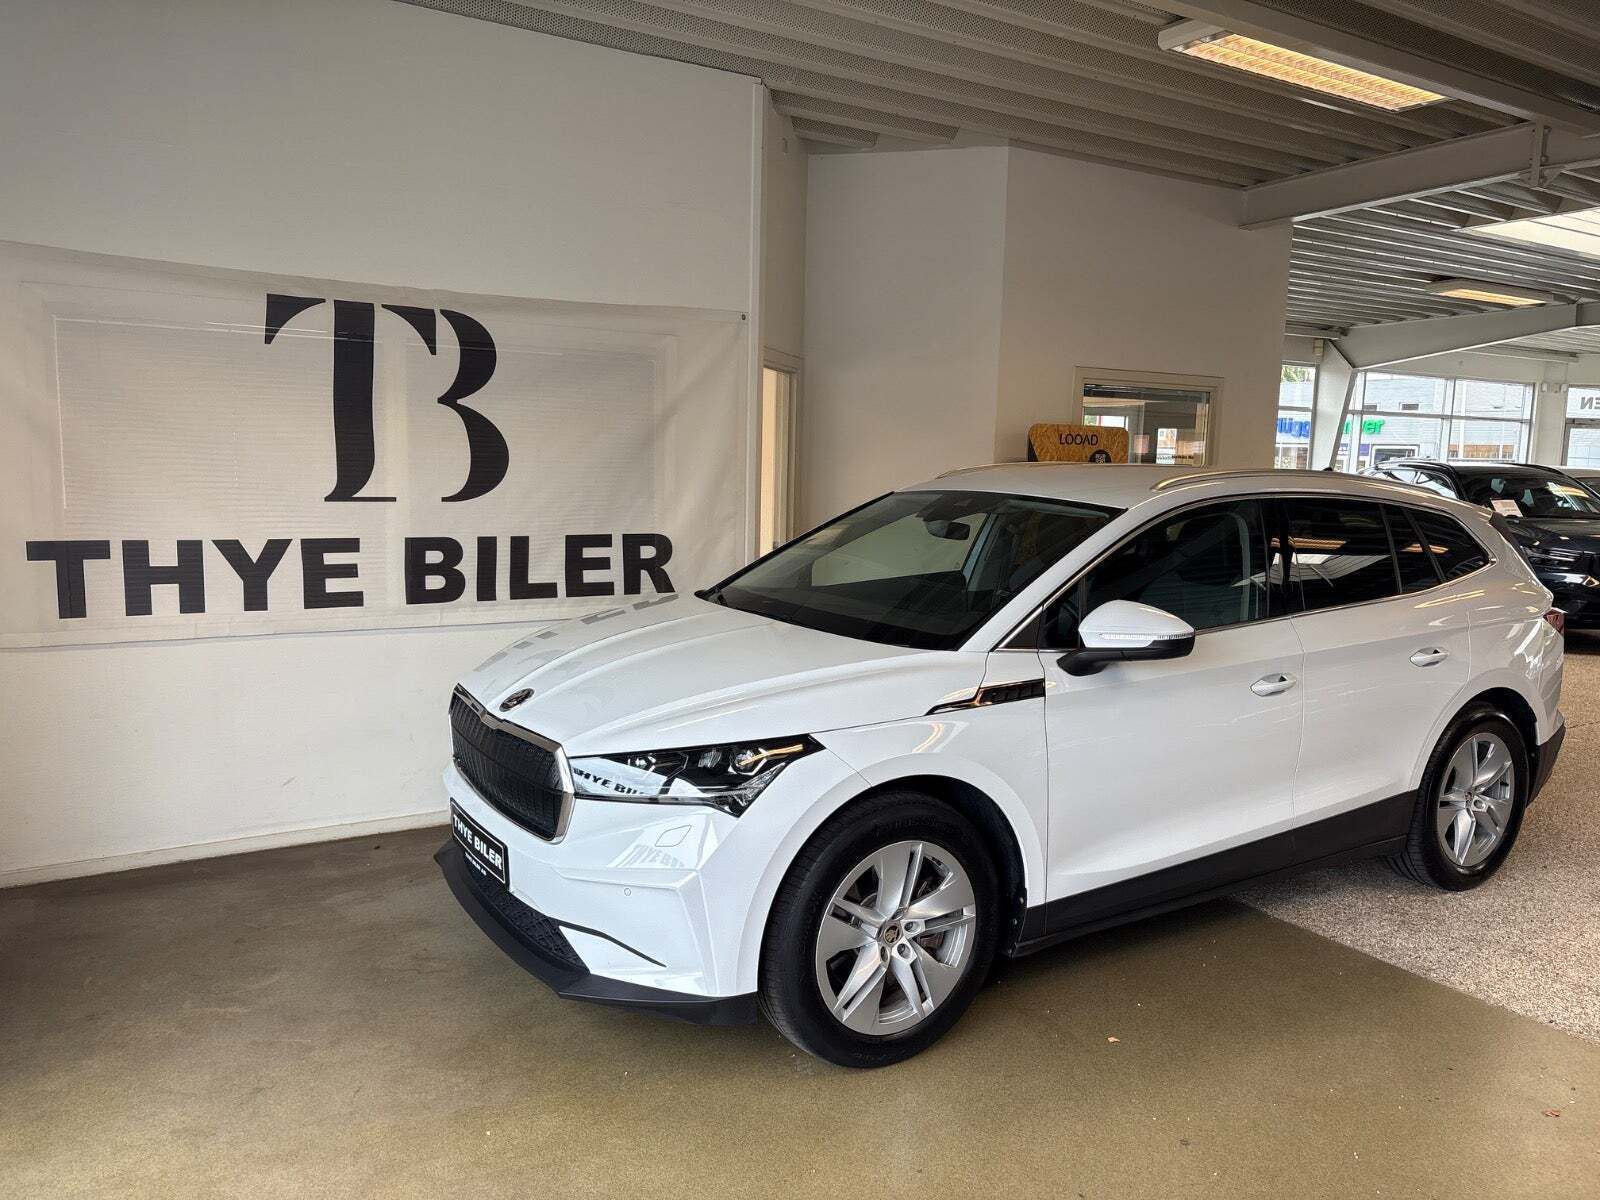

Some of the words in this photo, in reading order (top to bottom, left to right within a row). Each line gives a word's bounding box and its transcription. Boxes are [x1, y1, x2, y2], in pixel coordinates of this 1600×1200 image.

[264, 293, 509, 502] TB
[1059, 433, 1099, 446] LOOAD
[26, 537, 364, 619] THYE
[405, 533, 675, 604] BILER
[453, 814, 473, 844] THYE
[474, 835, 502, 870] BILER
